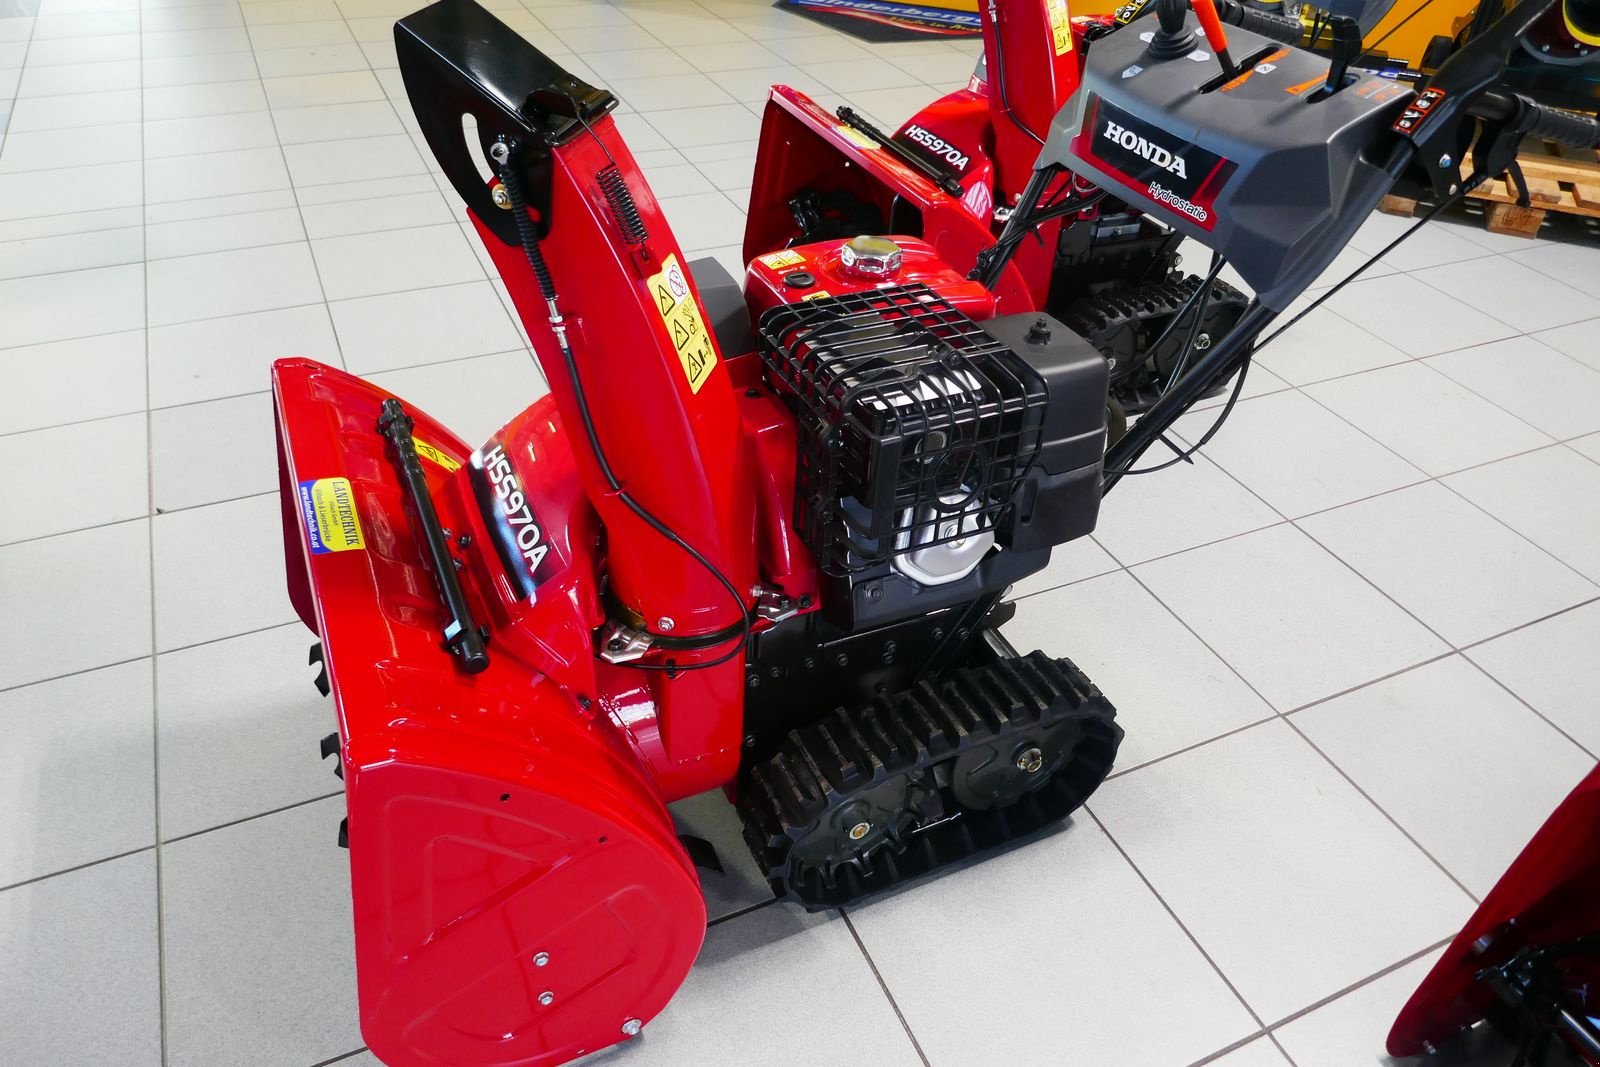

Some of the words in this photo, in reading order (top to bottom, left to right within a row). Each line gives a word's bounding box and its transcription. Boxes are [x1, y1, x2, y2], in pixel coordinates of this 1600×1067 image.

[904, 124, 969, 171] HSS970A
[1103, 120, 1187, 180] HONDA
[1147, 180, 1208, 223] Hydrostatic
[301, 486, 320, 548] www.landtechnik.co.at
[332, 481, 360, 546] LANDTECHNIK
[483, 444, 549, 573] HSS970A
